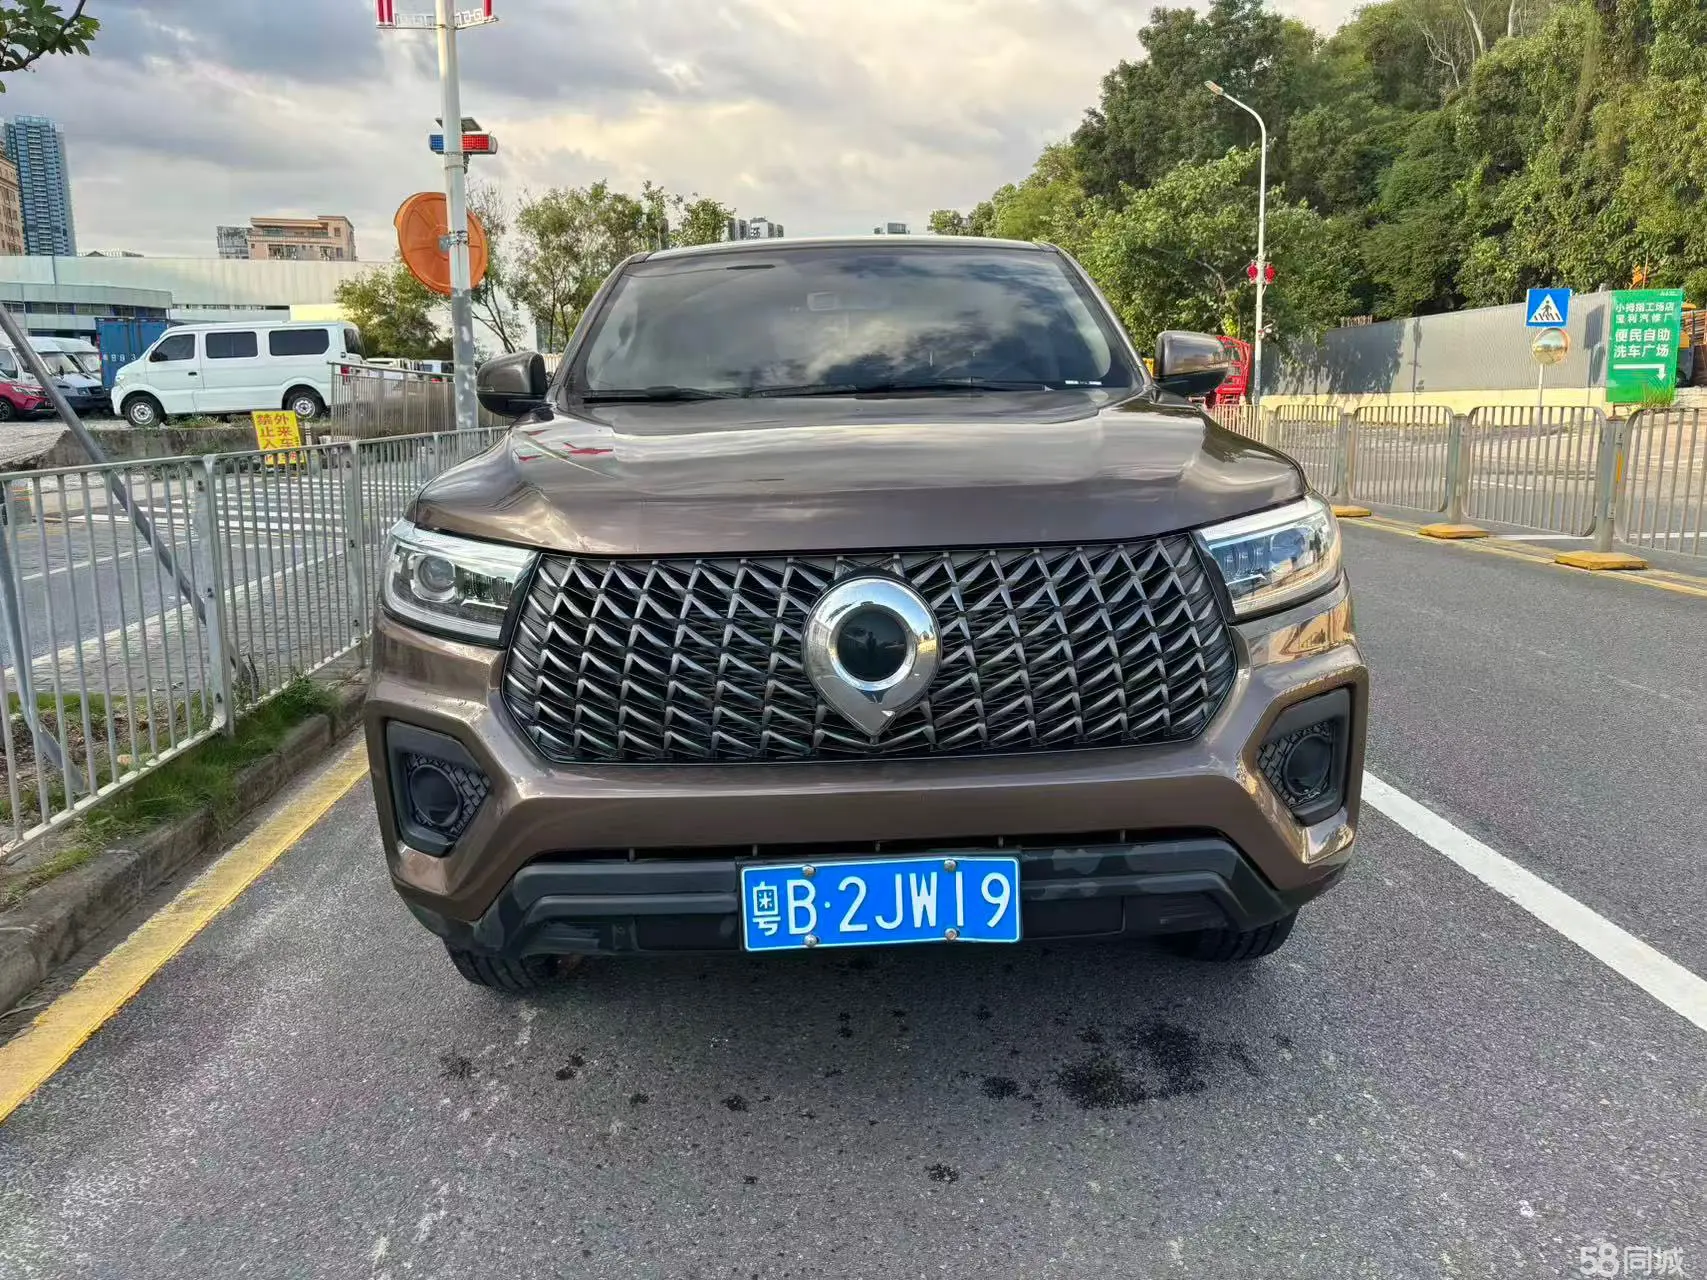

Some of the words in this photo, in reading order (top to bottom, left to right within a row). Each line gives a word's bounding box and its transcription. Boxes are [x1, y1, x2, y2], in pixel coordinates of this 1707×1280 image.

[1615, 327, 1671, 342] 便民自助
[1614, 343, 1669, 358] 洗车广场
